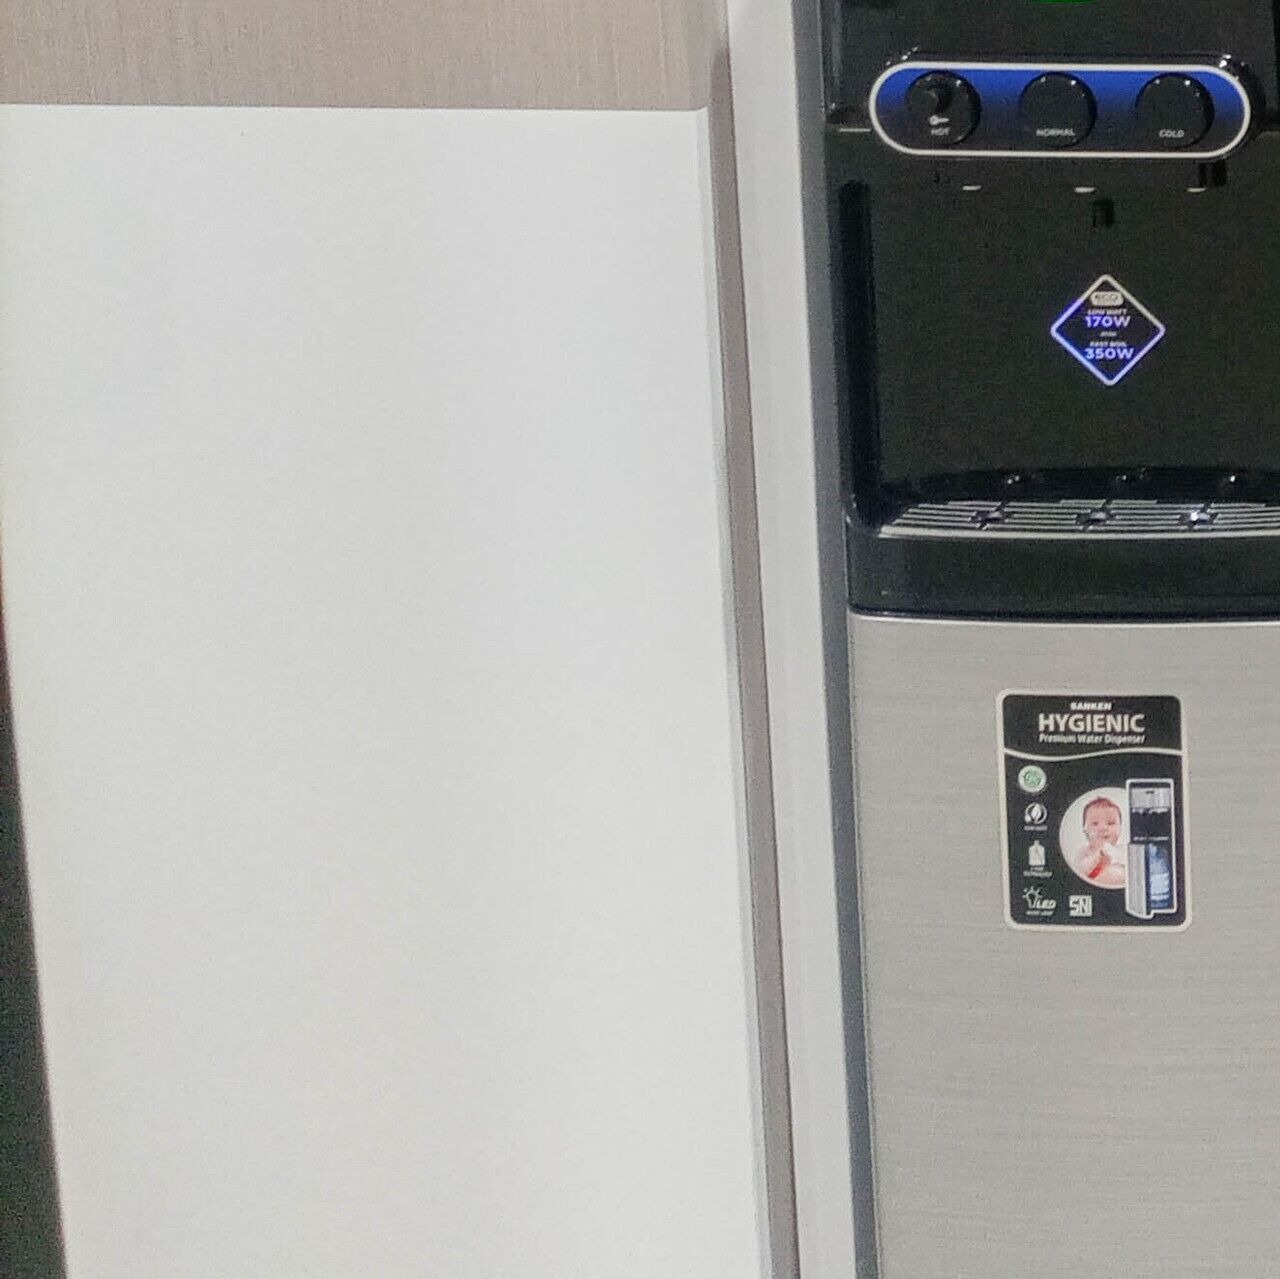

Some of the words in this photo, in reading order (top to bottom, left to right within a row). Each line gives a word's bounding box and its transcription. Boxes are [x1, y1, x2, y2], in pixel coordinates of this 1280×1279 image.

[1036, 127, 1076, 138] NORMAL
[1158, 128, 1185, 139] COLD
[1085, 315, 1131, 328] 170W
[1084, 347, 1134, 360] 350W
[1070, 702, 1112, 711] SANKEN
[1038, 713, 1145, 733] HYGIENIC
[1039, 732, 1076, 744] Premium
[1077, 733, 1102, 744] Water
[1104, 733, 1145, 746] Dispenser
